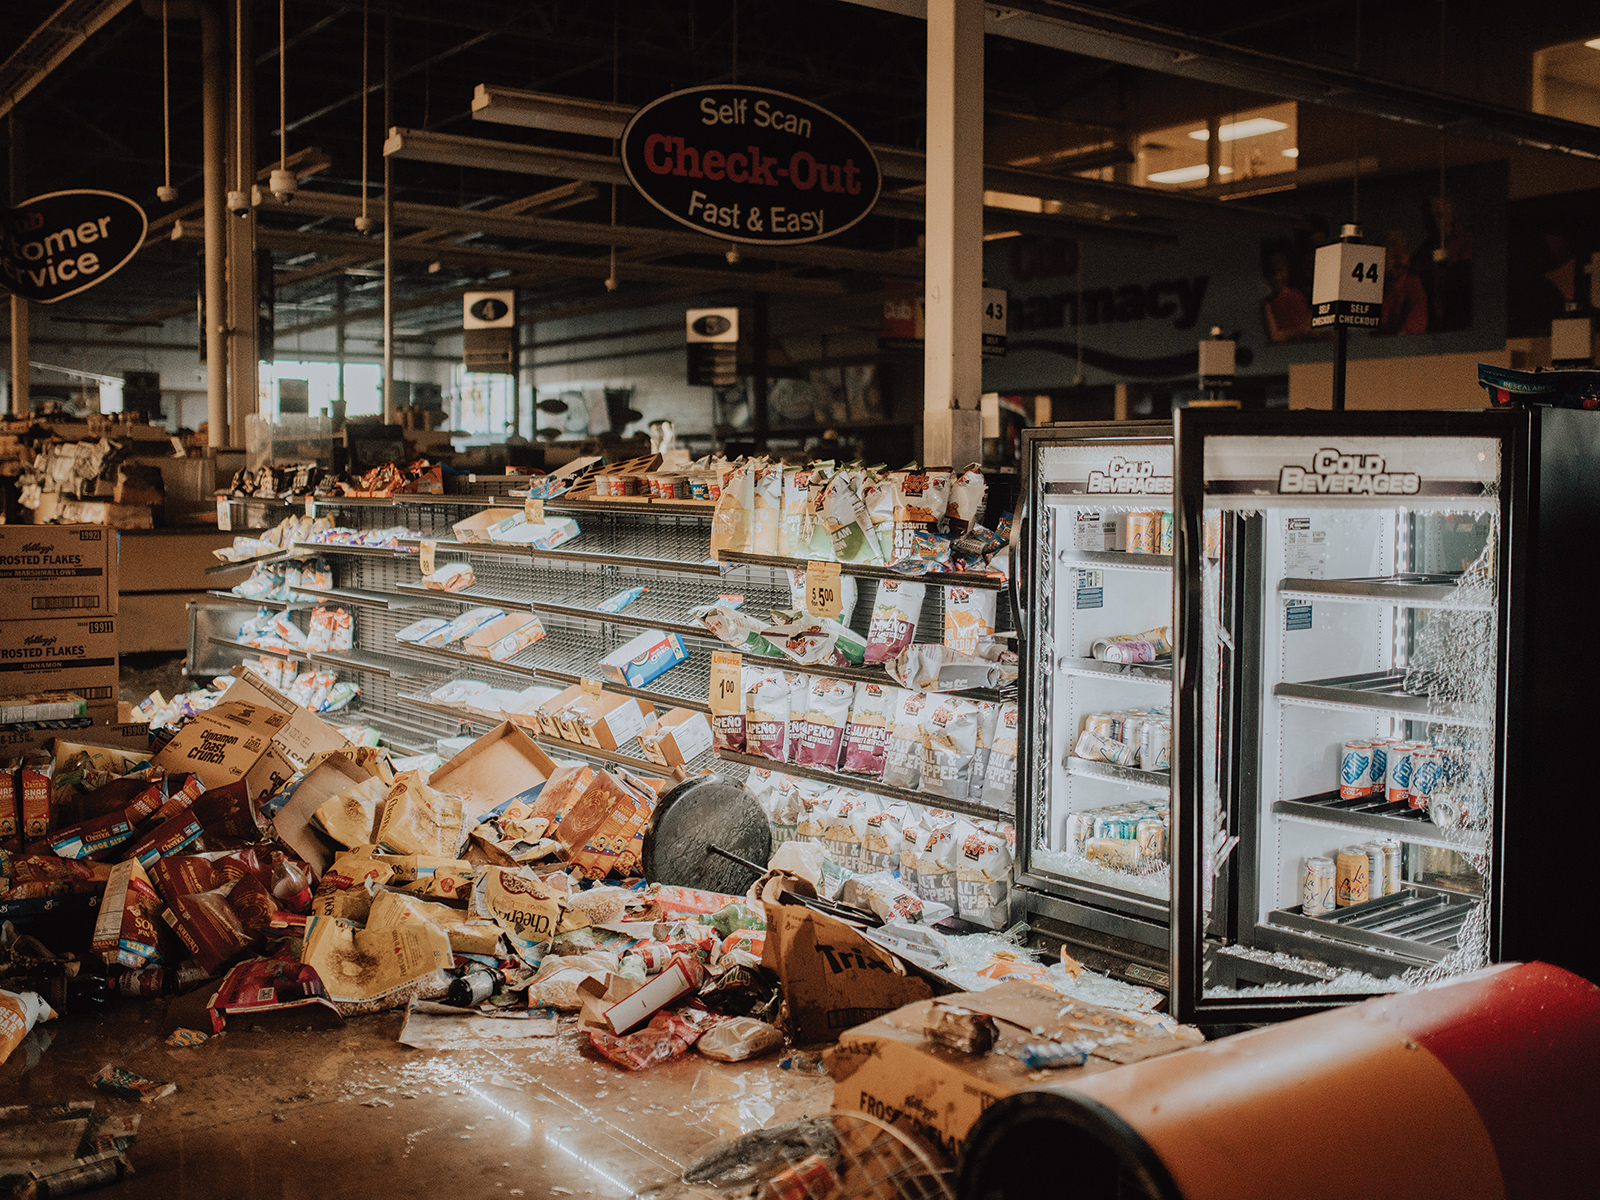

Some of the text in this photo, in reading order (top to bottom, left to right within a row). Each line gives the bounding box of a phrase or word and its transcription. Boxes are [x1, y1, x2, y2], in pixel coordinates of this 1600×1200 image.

[700, 96, 813, 139] Self Scan
[643, 132, 862, 196] Check-Out
[687, 189, 826, 235] Fast & Easy
[1352, 262, 1379, 283] 44
[985, 302, 1003, 321] 43
[1349, 304, 1371, 315] SELF
[1337, 313, 1381, 328] CHECKOUT
[1109, 456, 1153, 478] COLD
[1313, 448, 1386, 476] COLD
[1086, 470, 1174, 494] BEVERAGES
[1278, 466, 1422, 495] BEVERAGES
[43, 554, 81, 565] FLAKES
[1, 645, 85, 659] ROSTED FLAKES
[22, 661, 63, 670] CINNAMON
[200, 729, 239, 746] Cinnamon
[200, 739, 226, 754] Toast
[187, 747, 226, 765] Crunch
[83, 840, 109, 854] LARGE
[1352, 865, 1365, 885] La
[1339, 878, 1368, 902] Croix
[814, 943, 893, 976] Trix
